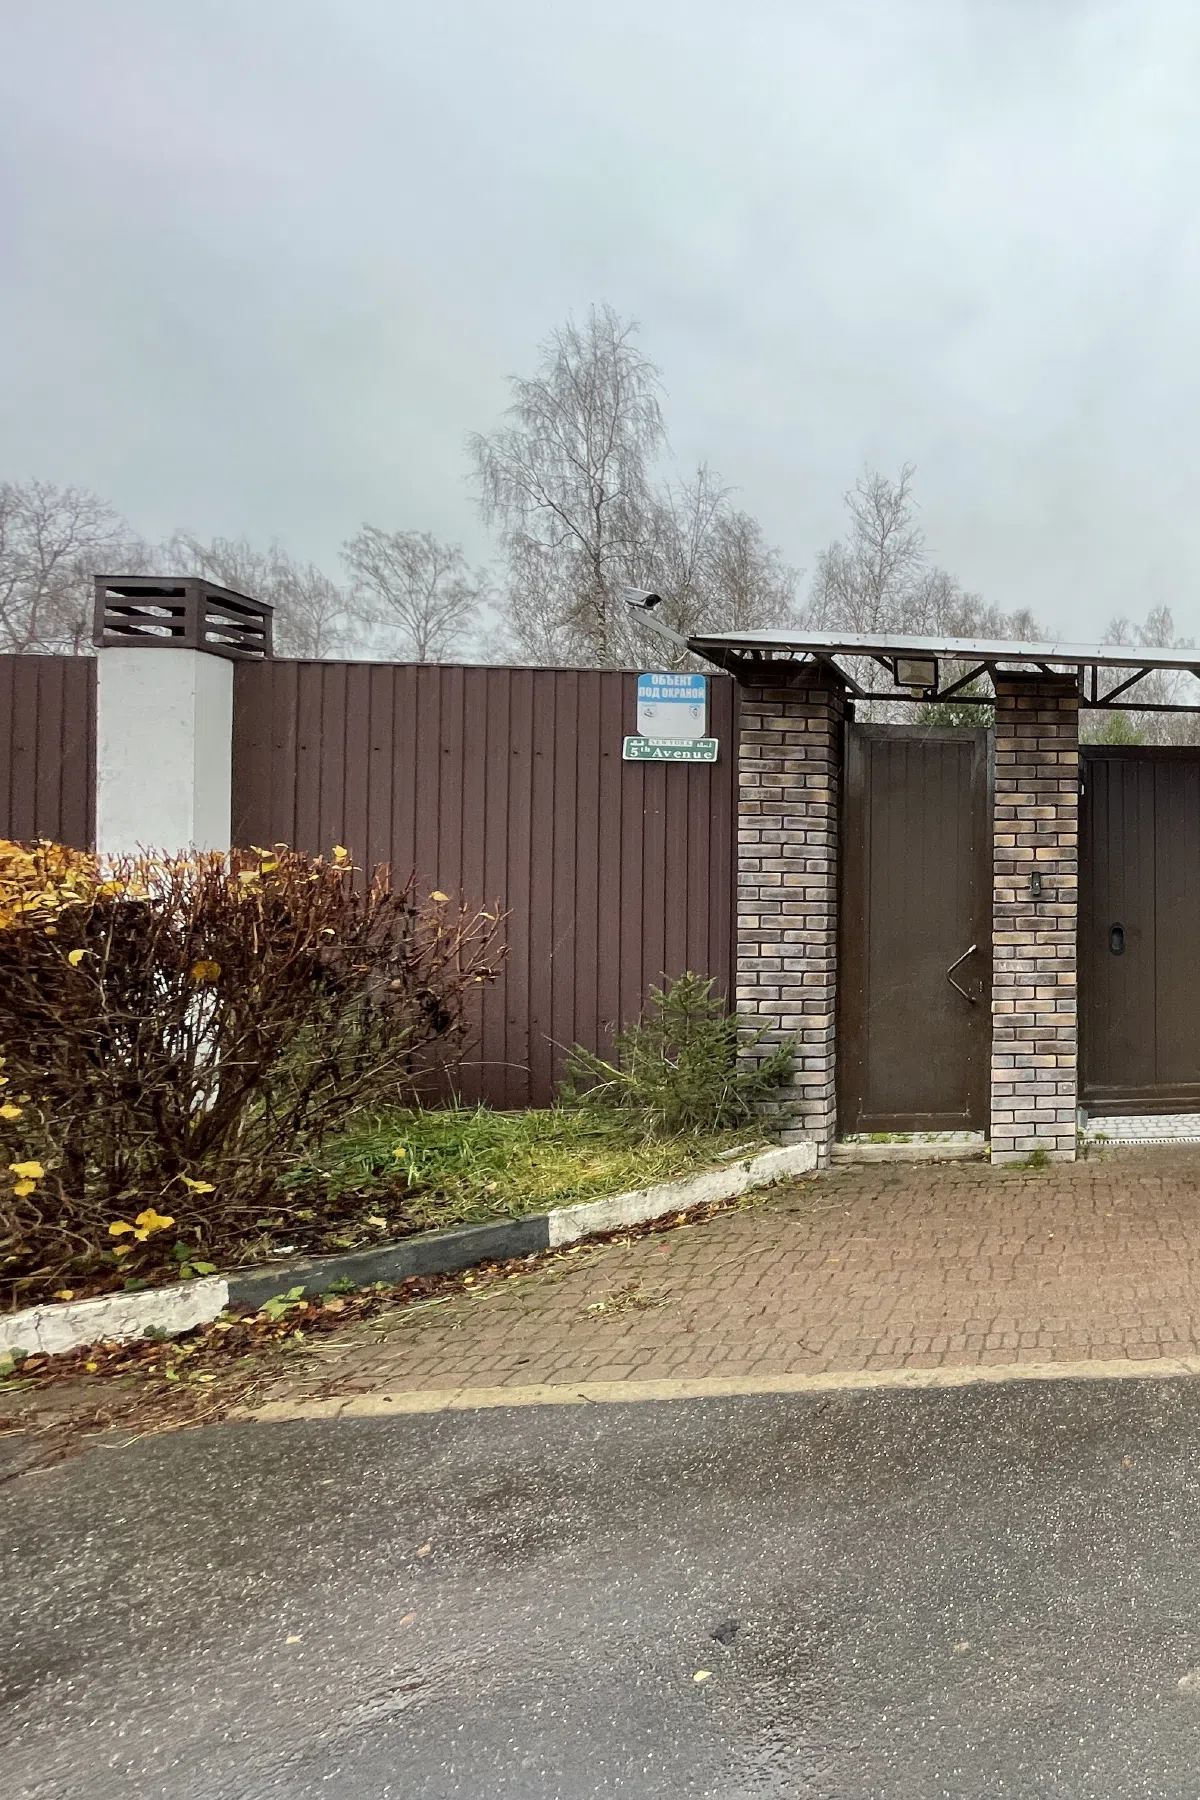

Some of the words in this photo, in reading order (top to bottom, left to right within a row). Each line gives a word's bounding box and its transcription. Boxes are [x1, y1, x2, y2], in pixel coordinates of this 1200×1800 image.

[651, 674, 692, 686] ОБЪЕКТ
[638, 687, 660, 699] ПОД
[661, 687, 704, 699] ОХРАНОЙ
[629, 746, 651, 757] 5th
[651, 747, 712, 759] Avenue
